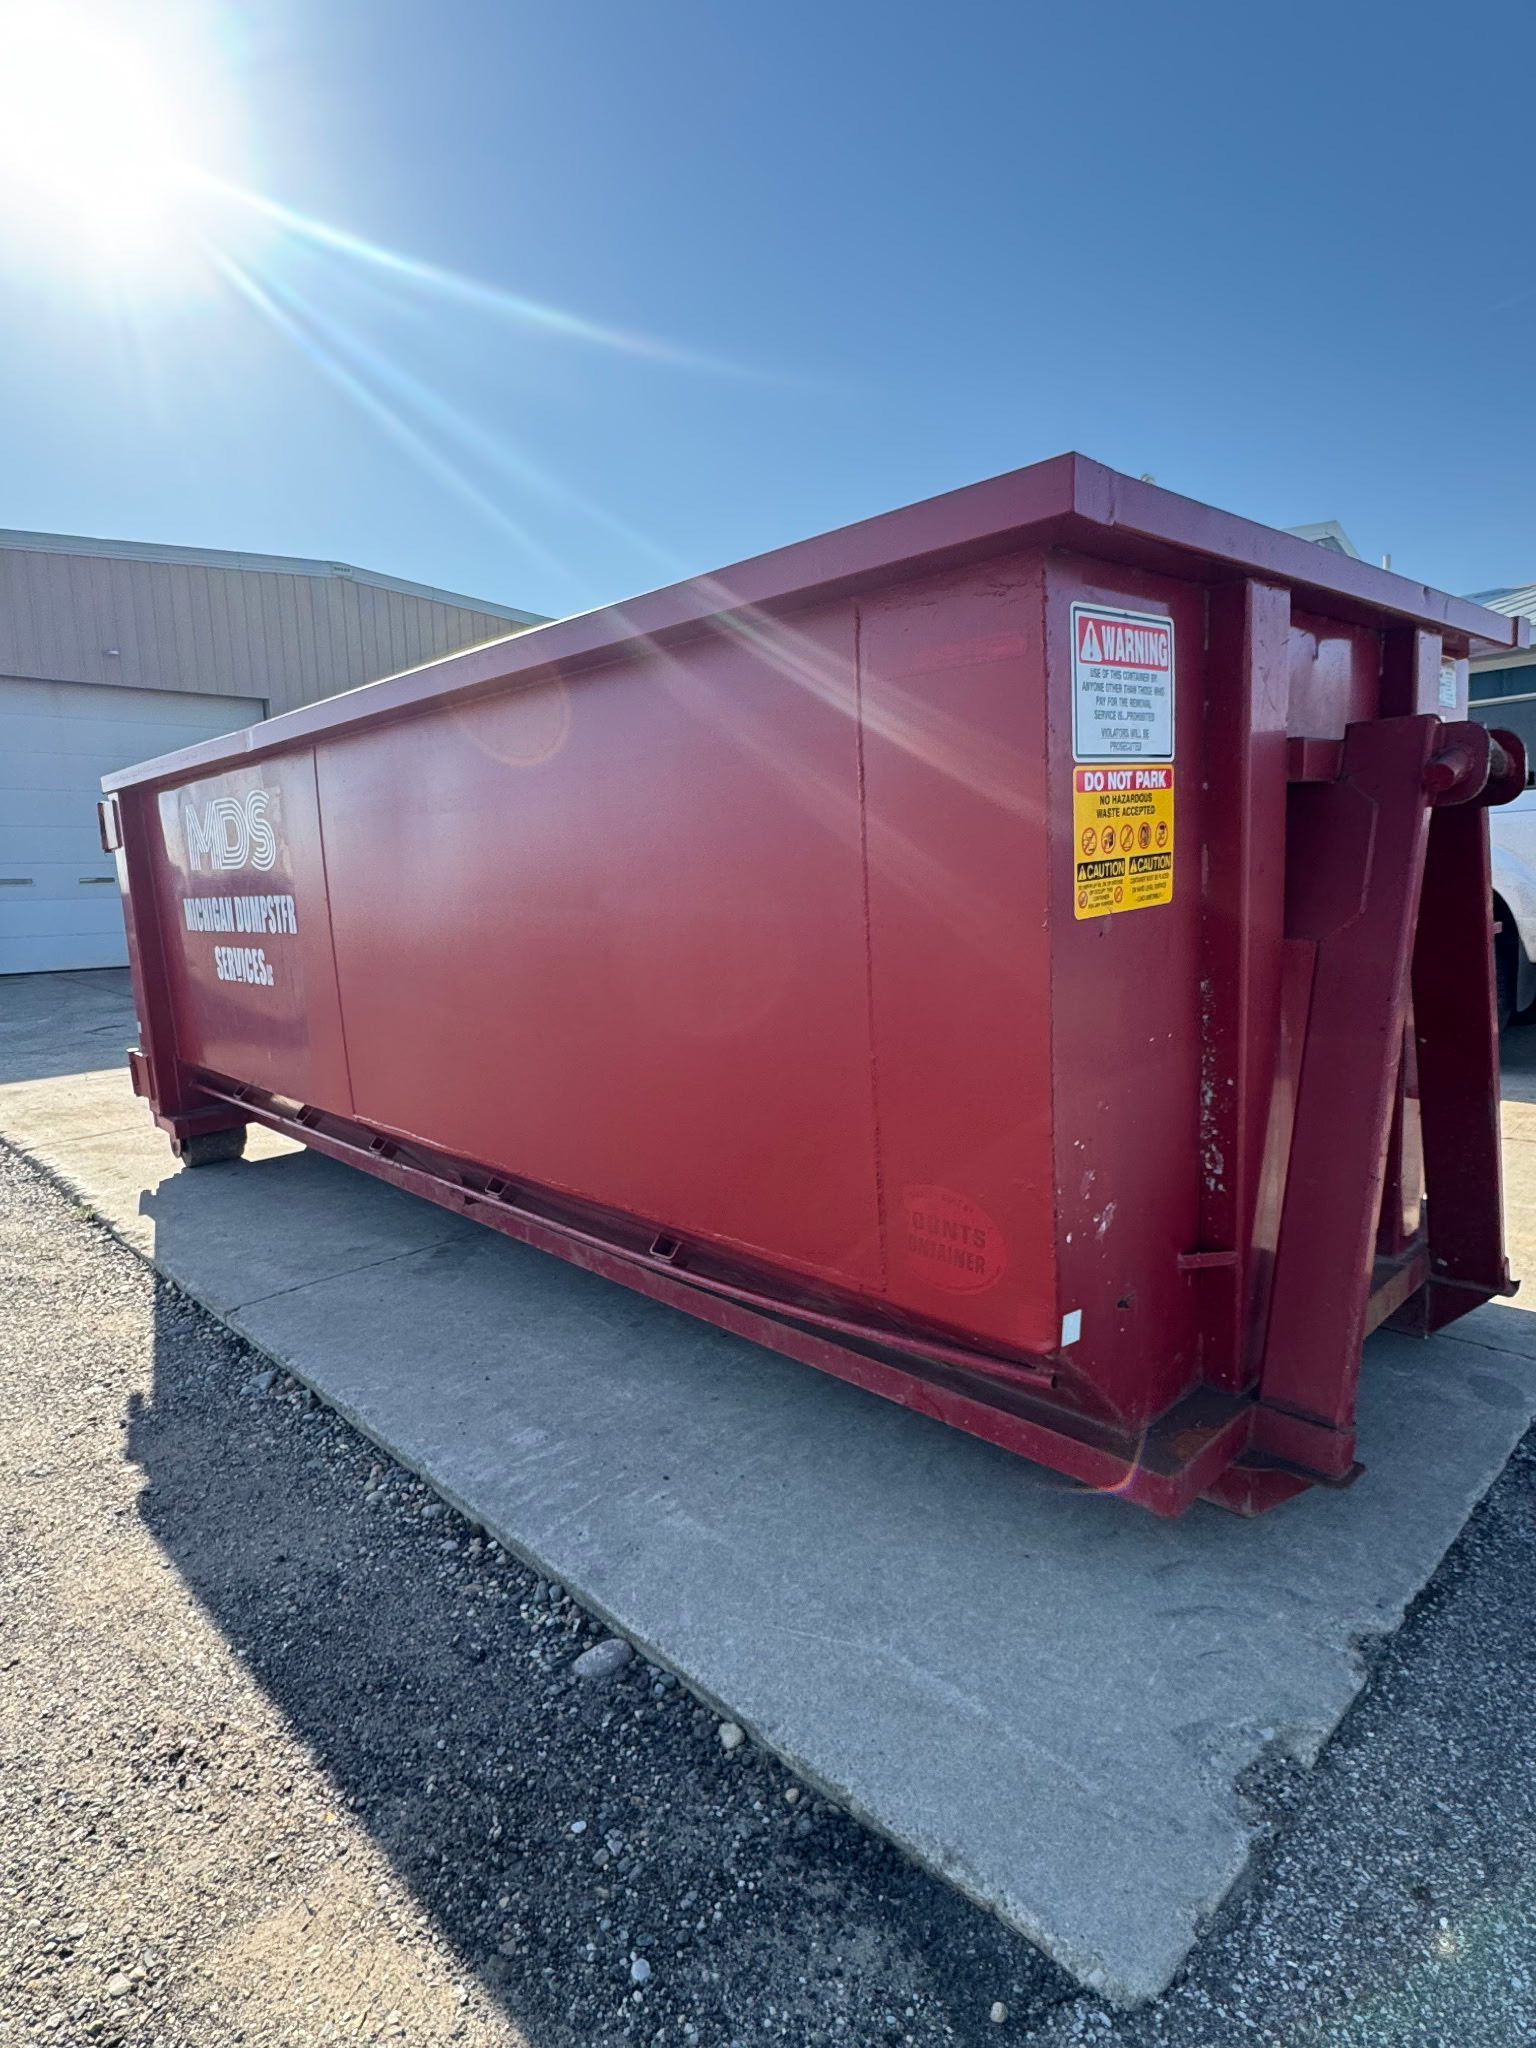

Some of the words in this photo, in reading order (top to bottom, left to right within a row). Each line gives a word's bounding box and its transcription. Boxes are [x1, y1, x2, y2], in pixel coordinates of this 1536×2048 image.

[1101, 625, 1168, 667] WARNING
[1082, 681, 1105, 692] ANYONE
[1096, 696, 1106, 706] PAY
[1107, 696, 1118, 707] FOR
[1119, 697, 1128, 708] THE
[1094, 709, 1116, 721] SERVICE
[1084, 771, 1104, 792] DO
[1107, 771, 1133, 790] NOT
[1136, 770, 1167, 789] PARK
[1099, 795, 1110, 806] NO
[1112, 793, 1153, 804] HAZARDOUS
[1096, 808, 1120, 819] WASTE
[1122, 805, 1156, 818] ACCEPTED
[185, 789, 276, 872] MDS
[1086, 860, 1125, 880] CAUTION
[1137, 854, 1171, 872] CAUTION
[183, 896, 236, 932] MICHIGAN
[214, 945, 269, 986] SERVICES
